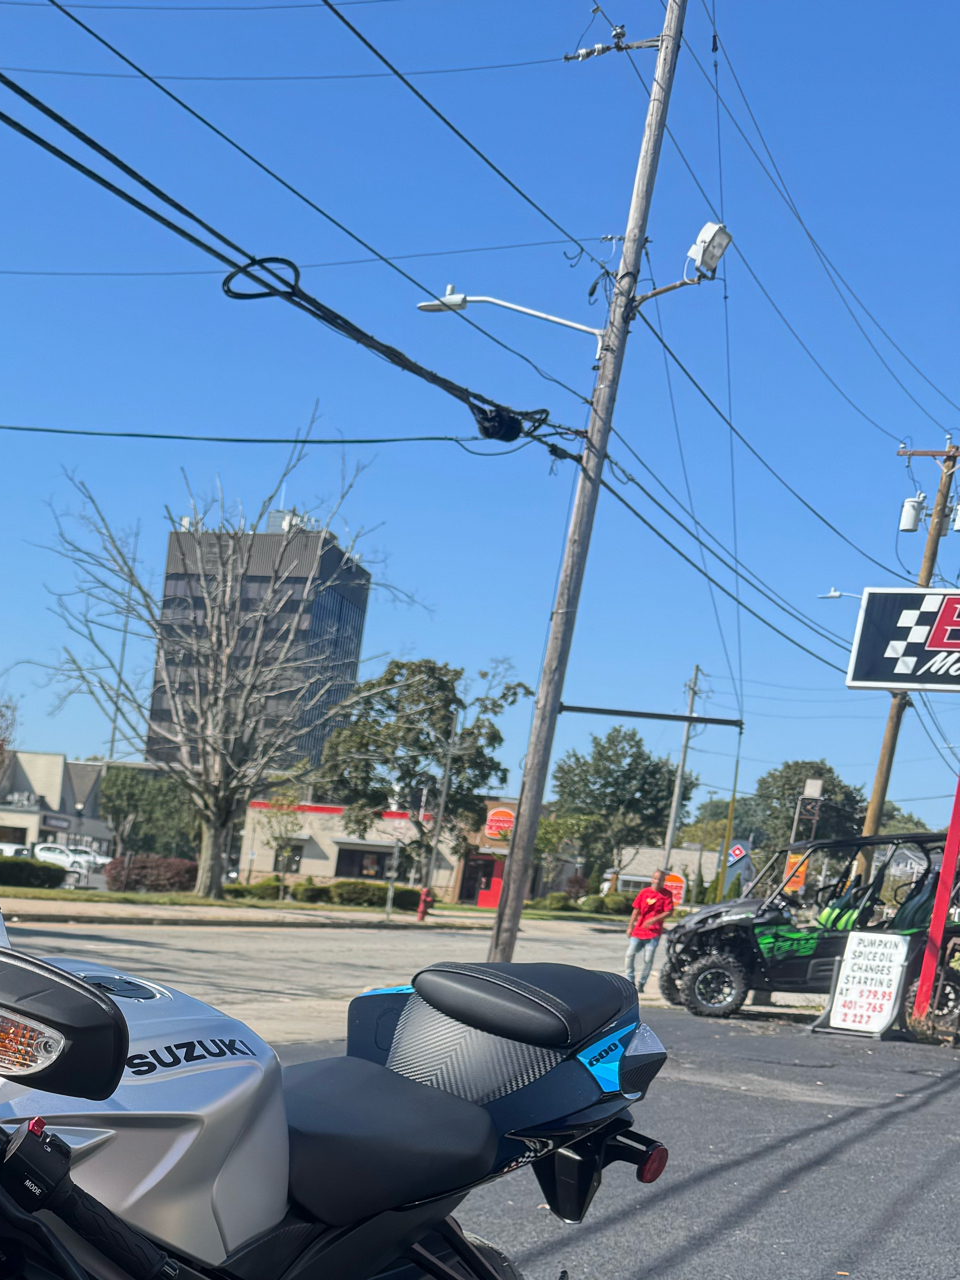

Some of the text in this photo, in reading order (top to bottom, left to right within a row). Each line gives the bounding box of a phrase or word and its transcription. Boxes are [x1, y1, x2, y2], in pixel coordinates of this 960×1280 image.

[856, 938, 900, 950] PUMPKIN
[851, 950, 894, 963] SPICE OIL
[850, 962, 892, 976] CHANGES
[843, 975, 893, 988] STARTING
[838, 987, 893, 1001] AT $79.95
[841, 1000, 885, 1013] 401-765
[125, 1038, 257, 1076] SUZUKI
[587, 1042, 619, 1068] 600
[24, 1179, 42, 1196] MODE
